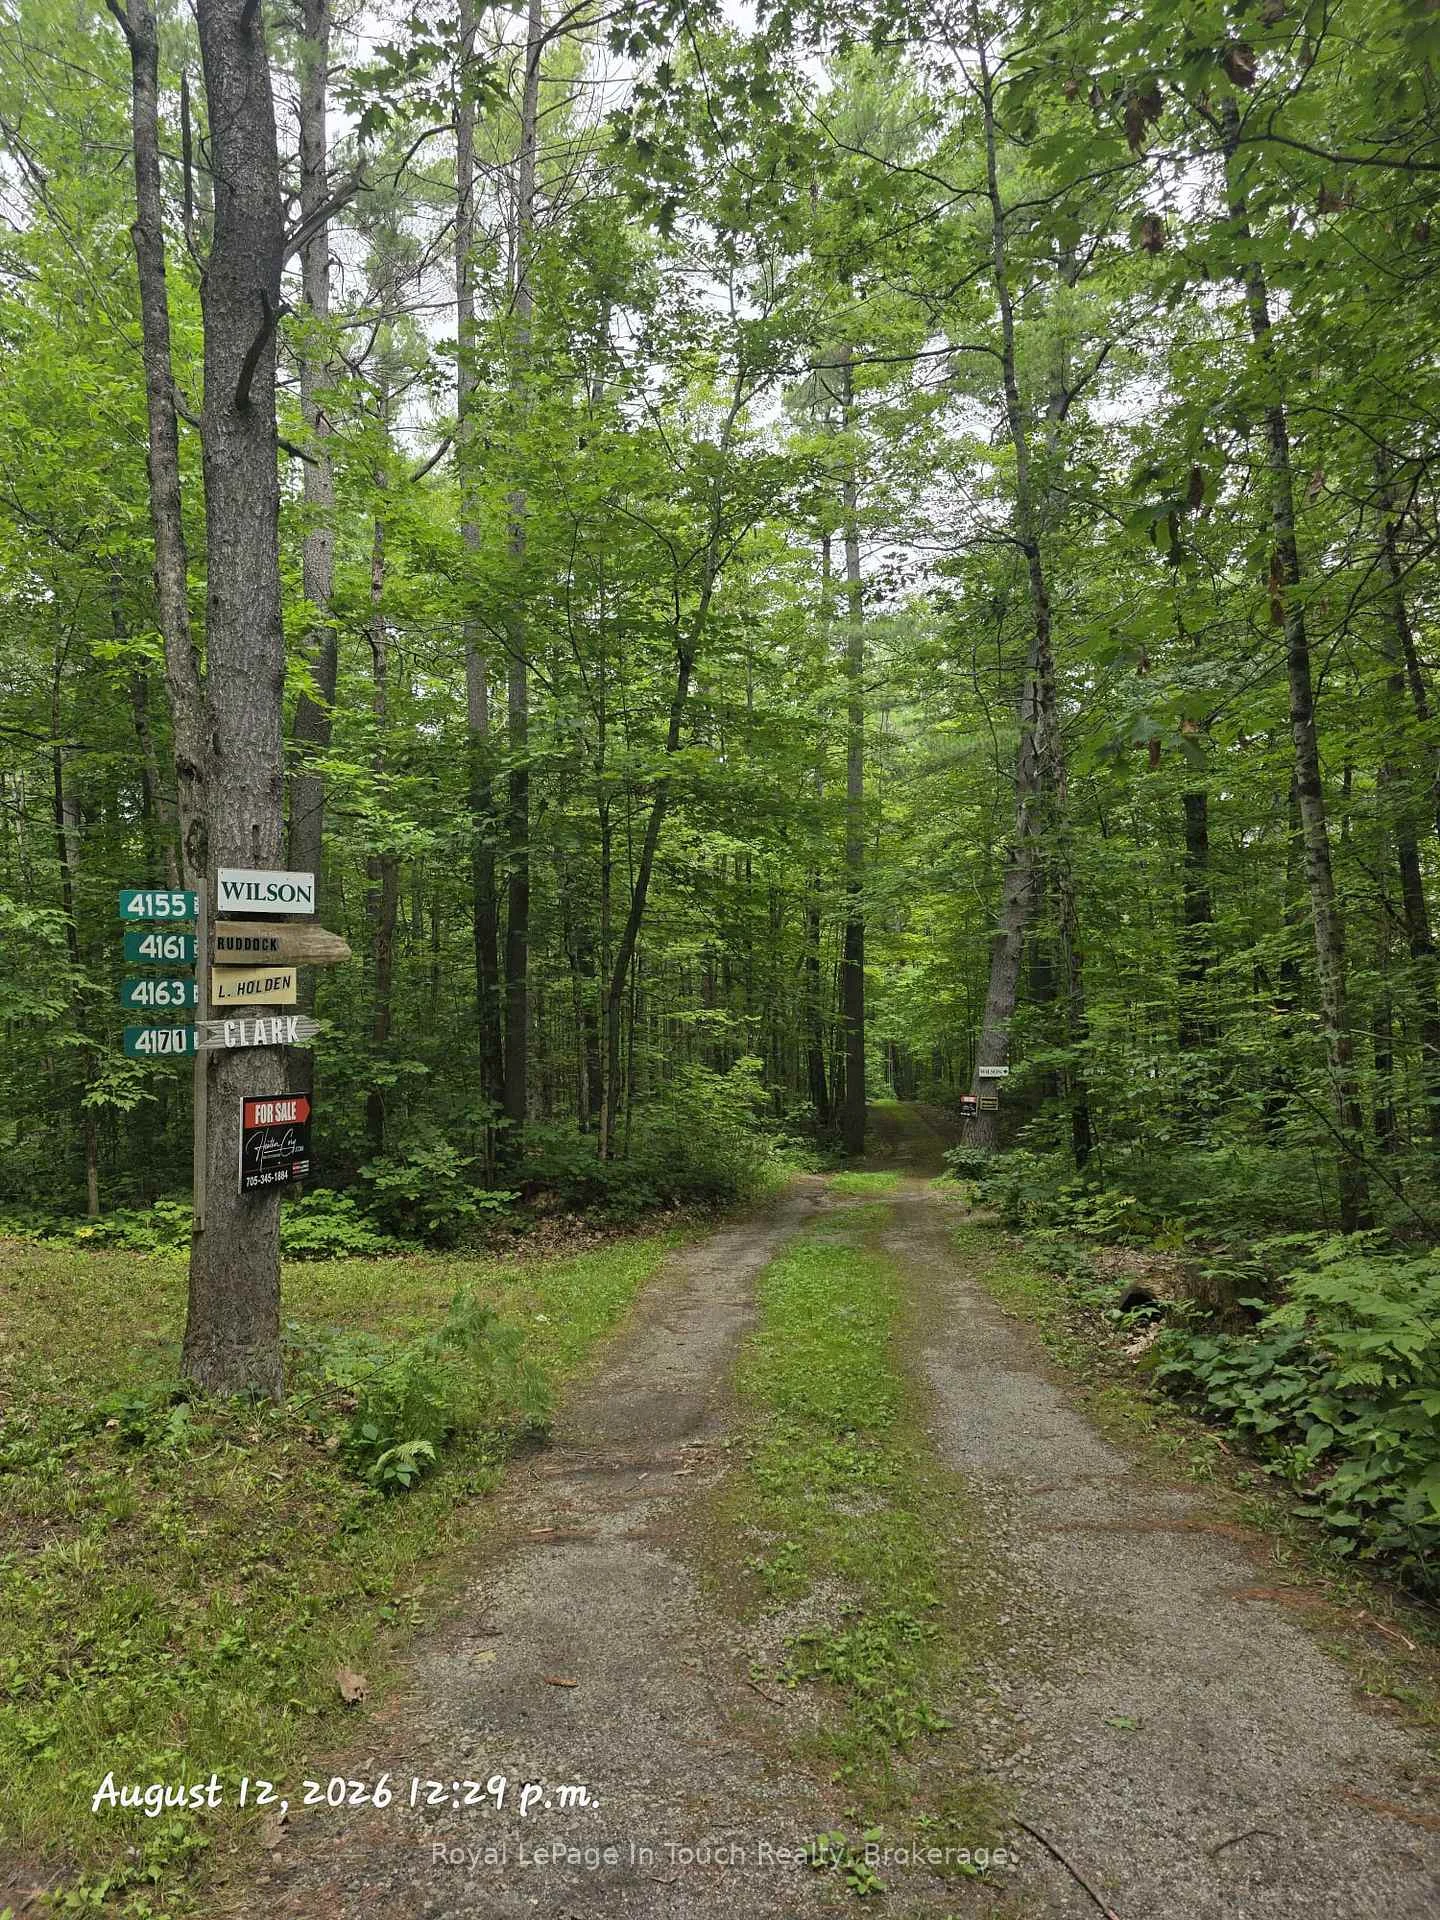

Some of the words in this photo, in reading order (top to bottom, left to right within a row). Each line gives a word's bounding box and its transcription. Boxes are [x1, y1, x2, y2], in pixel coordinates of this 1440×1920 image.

[221, 881, 313, 903] WILSON
[127, 893, 187, 917] 4155
[138, 934, 186, 959] 4161
[217, 936, 279, 952] RUDDOCK
[130, 981, 186, 1005] 4163
[218, 985, 231, 999] L.
[237, 975, 292, 997] HOLDEN
[223, 1015, 300, 1048] CLARK
[255, 1103, 273, 1125] FOR
[275, 1101, 297, 1122] SALE
